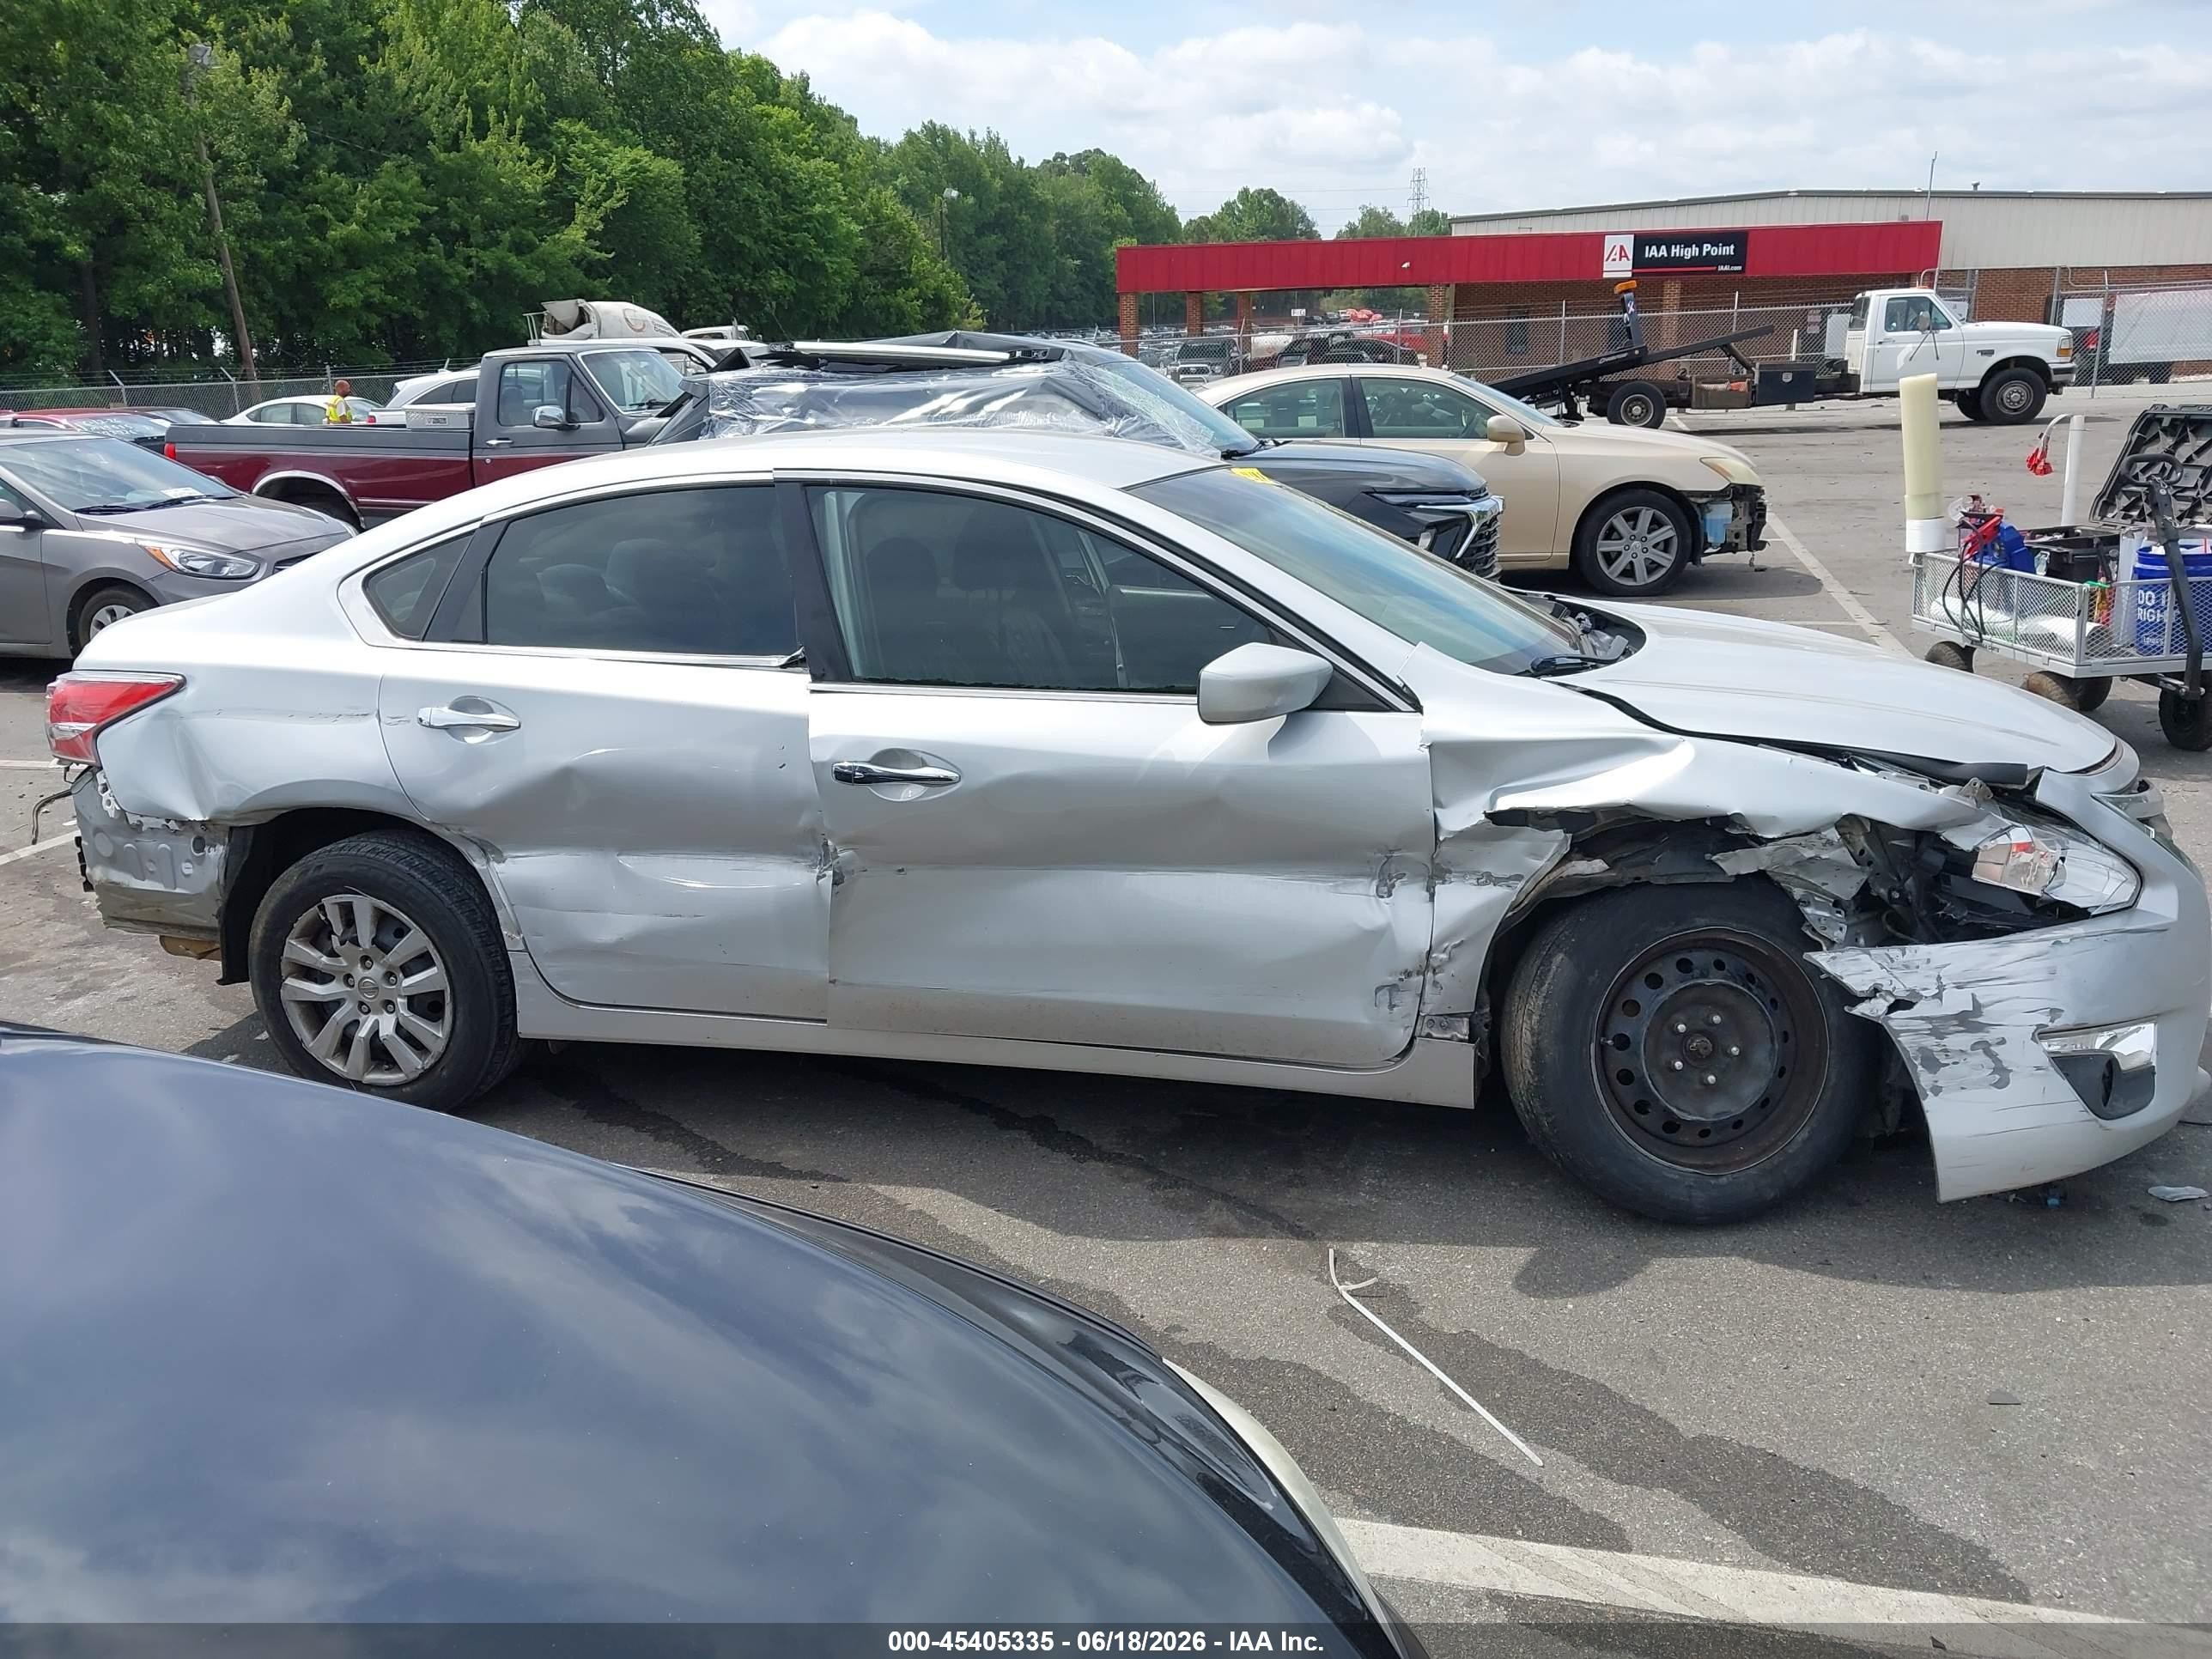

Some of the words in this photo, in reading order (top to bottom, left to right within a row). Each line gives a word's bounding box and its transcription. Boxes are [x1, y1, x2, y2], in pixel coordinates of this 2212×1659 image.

[1644, 245, 1668, 258] IAA
[1670, 244, 1699, 260] High
[1703, 243, 1735, 257] Point
[2137, 589, 2156, 606] DO
